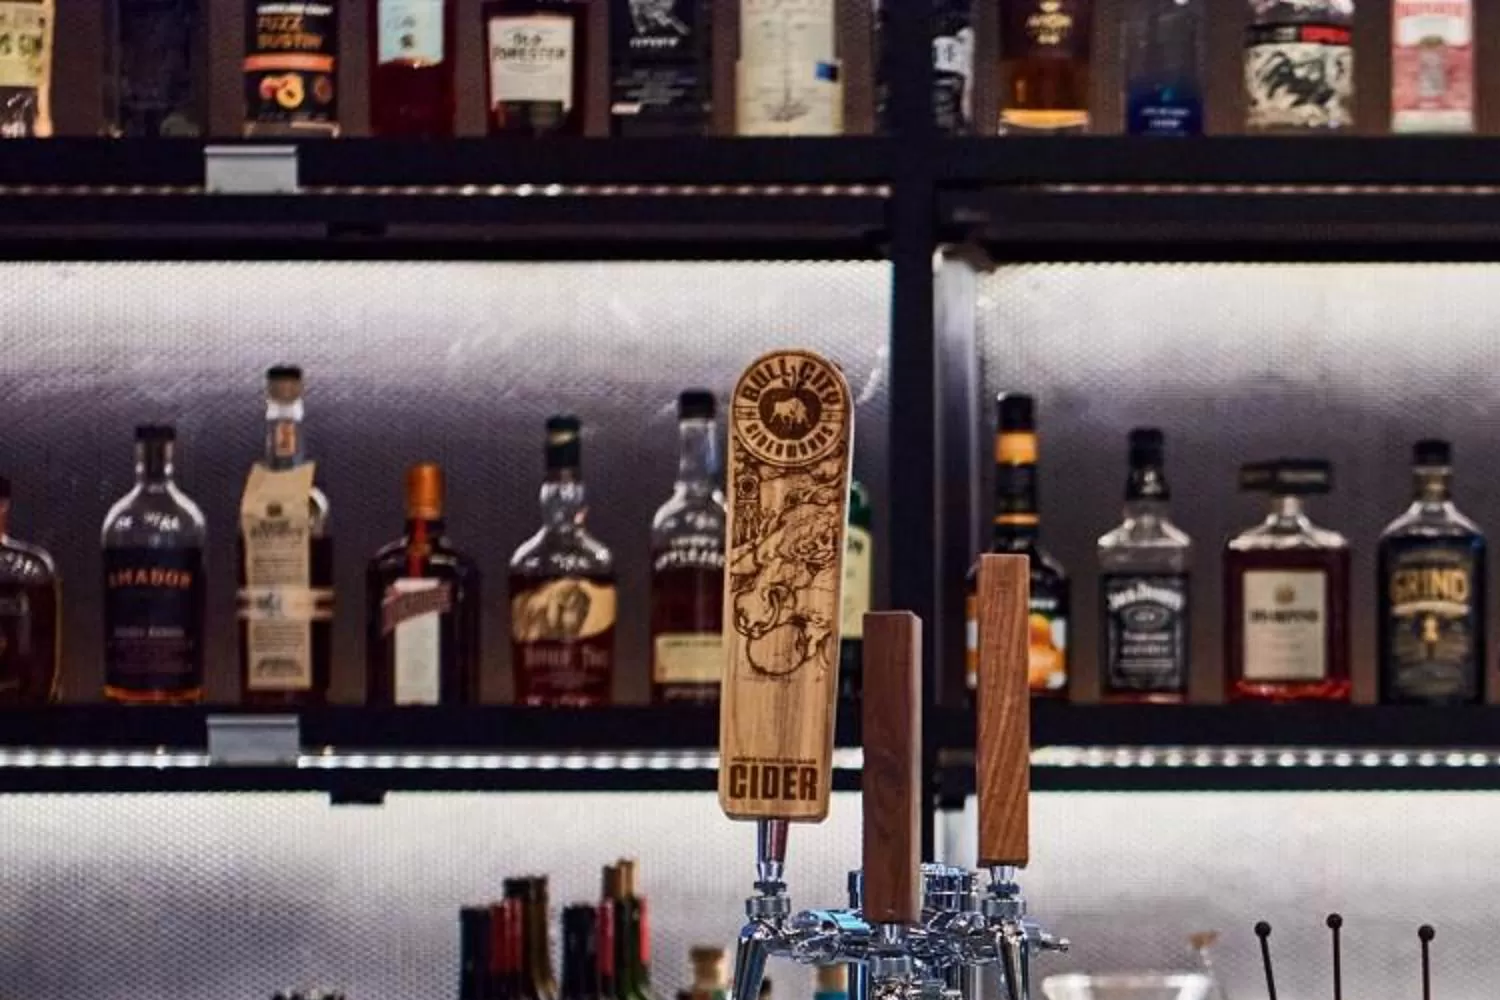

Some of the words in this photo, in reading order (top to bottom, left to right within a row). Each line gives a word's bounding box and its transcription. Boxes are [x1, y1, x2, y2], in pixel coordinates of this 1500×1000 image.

[741, 357, 792, 401] BULL
[799, 361, 842, 405] CITY
[729, 763, 818, 801] CIDER
